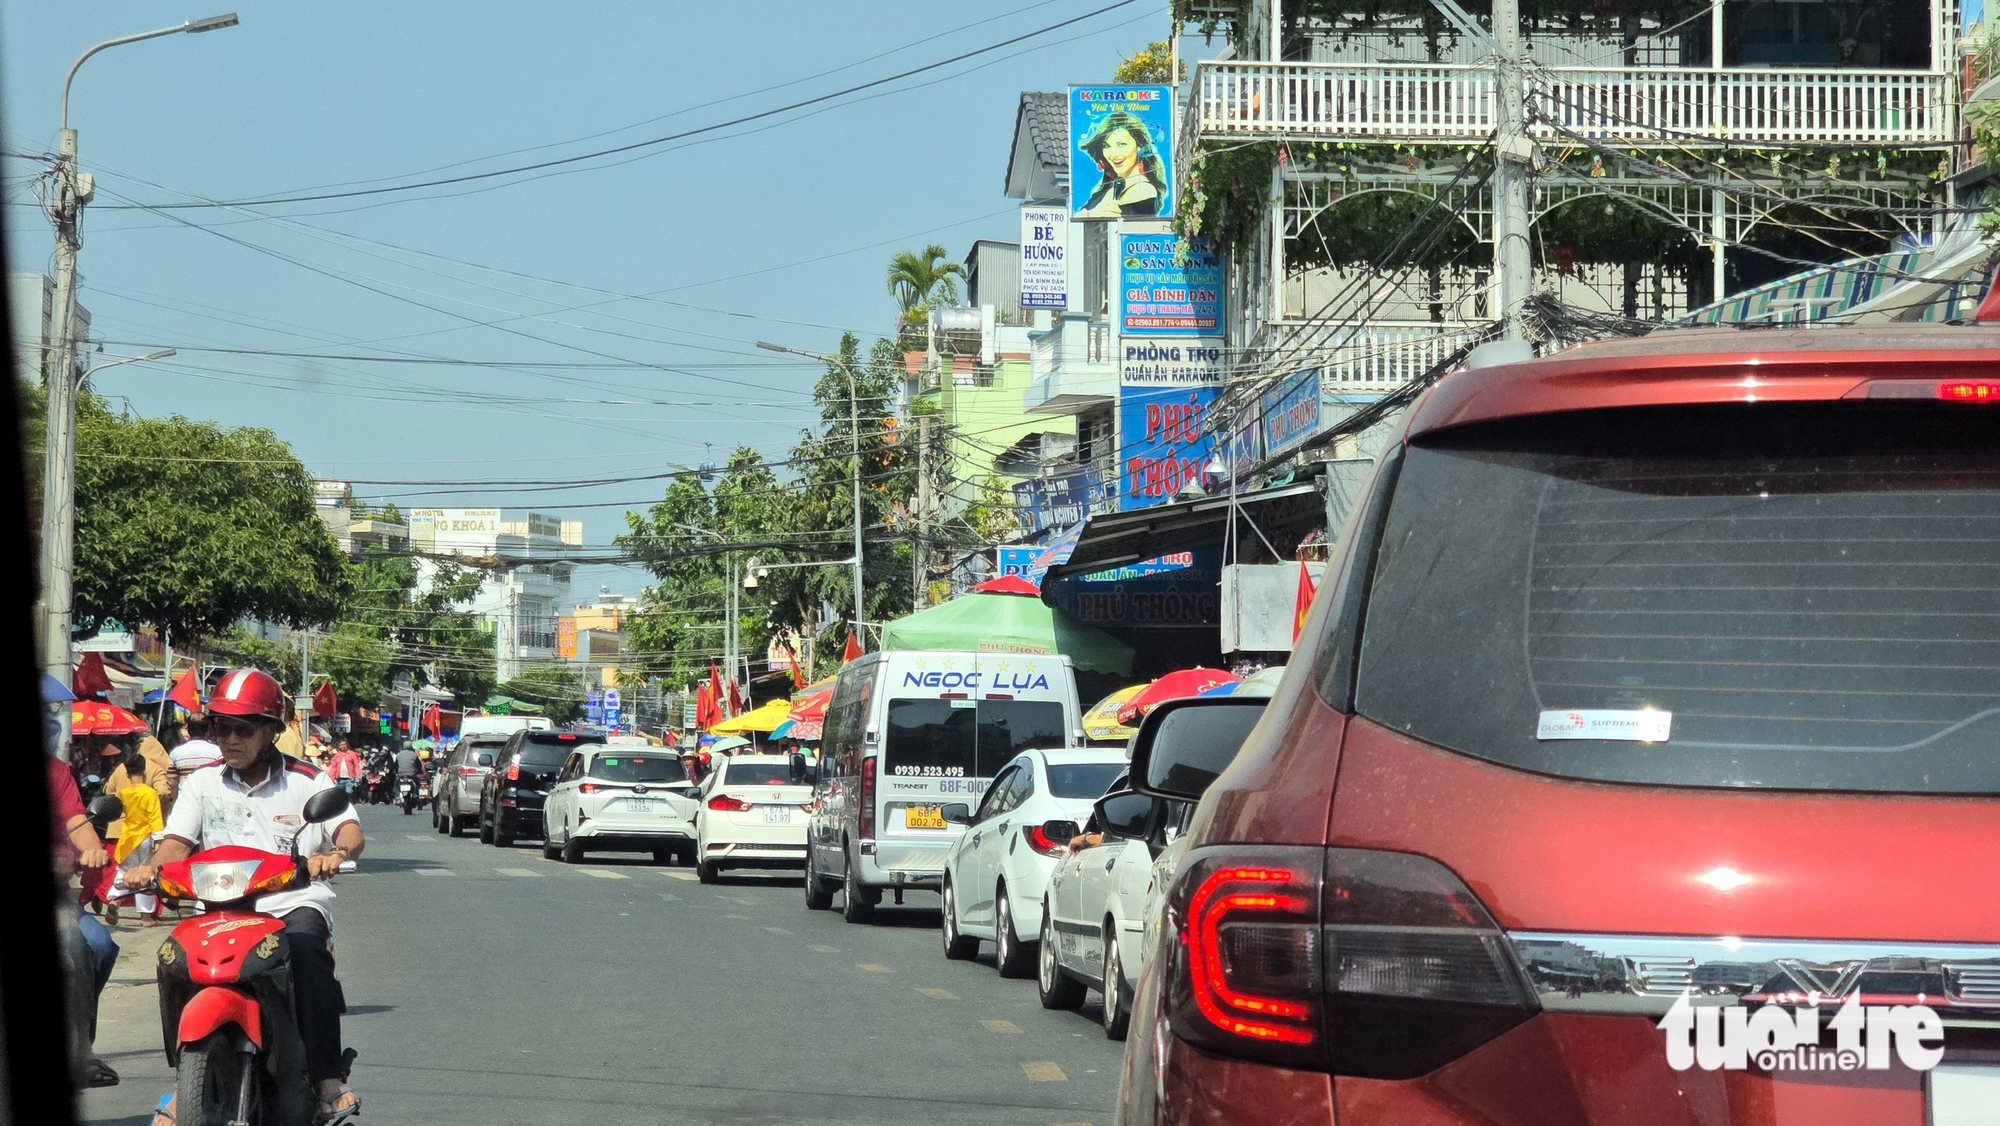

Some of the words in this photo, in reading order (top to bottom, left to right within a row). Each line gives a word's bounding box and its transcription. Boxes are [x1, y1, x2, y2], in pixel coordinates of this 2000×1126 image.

[1080, 90, 1161, 101] KARAOKE
[1050, 213, 1064, 223] TRỌ
[1034, 222, 1054, 240] BÉ
[1024, 242, 1064, 260] HƯƠNG
[1127, 240, 1160, 254] QUÁN
[1142, 256, 1165, 269] SÂN
[1146, 273, 1155, 284] VỤ
[1127, 286, 1149, 301] GIÁ
[1154, 286, 1185, 301] BÌNH
[1189, 288, 1216, 301] DÂN
[1128, 305, 1145, 315] PHỤC
[1147, 305, 1156, 315] VỤ
[1198, 306, 1216, 314] 24/24
[1126, 341, 1180, 361] PHÒNG
[1186, 346, 1220, 364] TRỌ
[1125, 364, 1151, 381] QUÁN
[1154, 364, 1167, 381] ĂN
[1172, 367, 1220, 382] KARAOKE
[1145, 392, 1201, 443] PHÚ
[1270, 406, 1286, 444] PHÚ
[1288, 395, 1317, 433] THÔNG
[452, 520, 486, 531] KHOA
[490, 520, 495, 531] 1
[1163, 552, 1193, 567] TRỌ
[1119, 567, 1137, 581] ĂN
[1145, 569, 1207, 581] KARAOKE
[1078, 585, 1127, 621] PHÚ
[1132, 585, 1216, 621] THÔNG
[903, 672, 982, 692] NGỌC
[993, 673, 1049, 694] LỤA
[895, 765, 964, 777] 0939.523.495
[940, 780, 991, 793] 68F-002
[770, 806, 783, 814] 67A
[918, 808, 936, 817] 68F
[911, 818, 942, 826] 002.78
